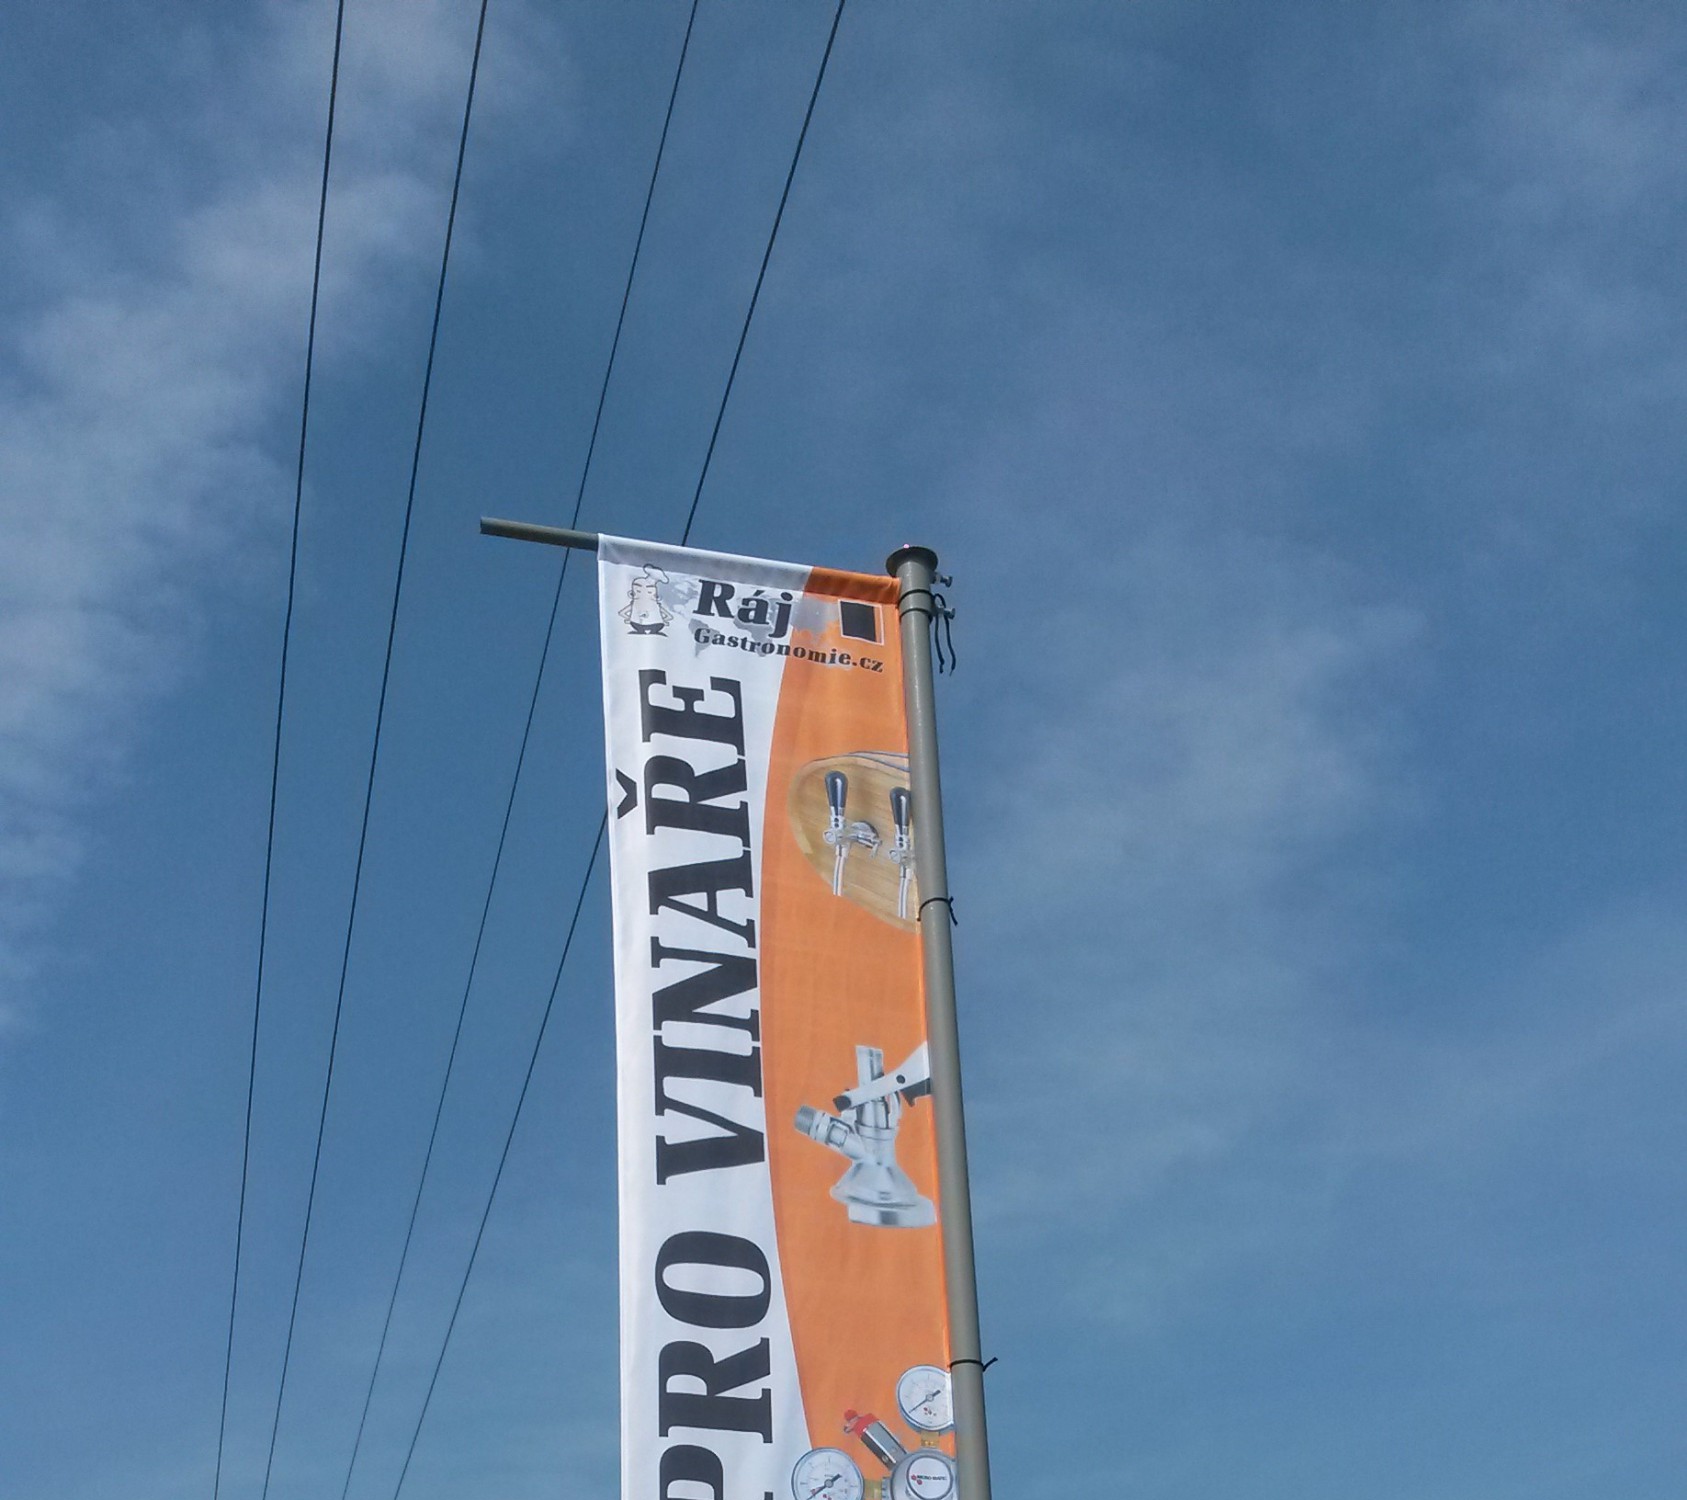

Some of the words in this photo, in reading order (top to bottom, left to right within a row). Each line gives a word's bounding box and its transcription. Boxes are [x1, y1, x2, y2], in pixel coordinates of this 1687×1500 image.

[693, 579, 795, 638] Ráj
[693, 626, 885, 674] Gastronomie.cz
[615, 668, 765, 1185] VINAŘE
